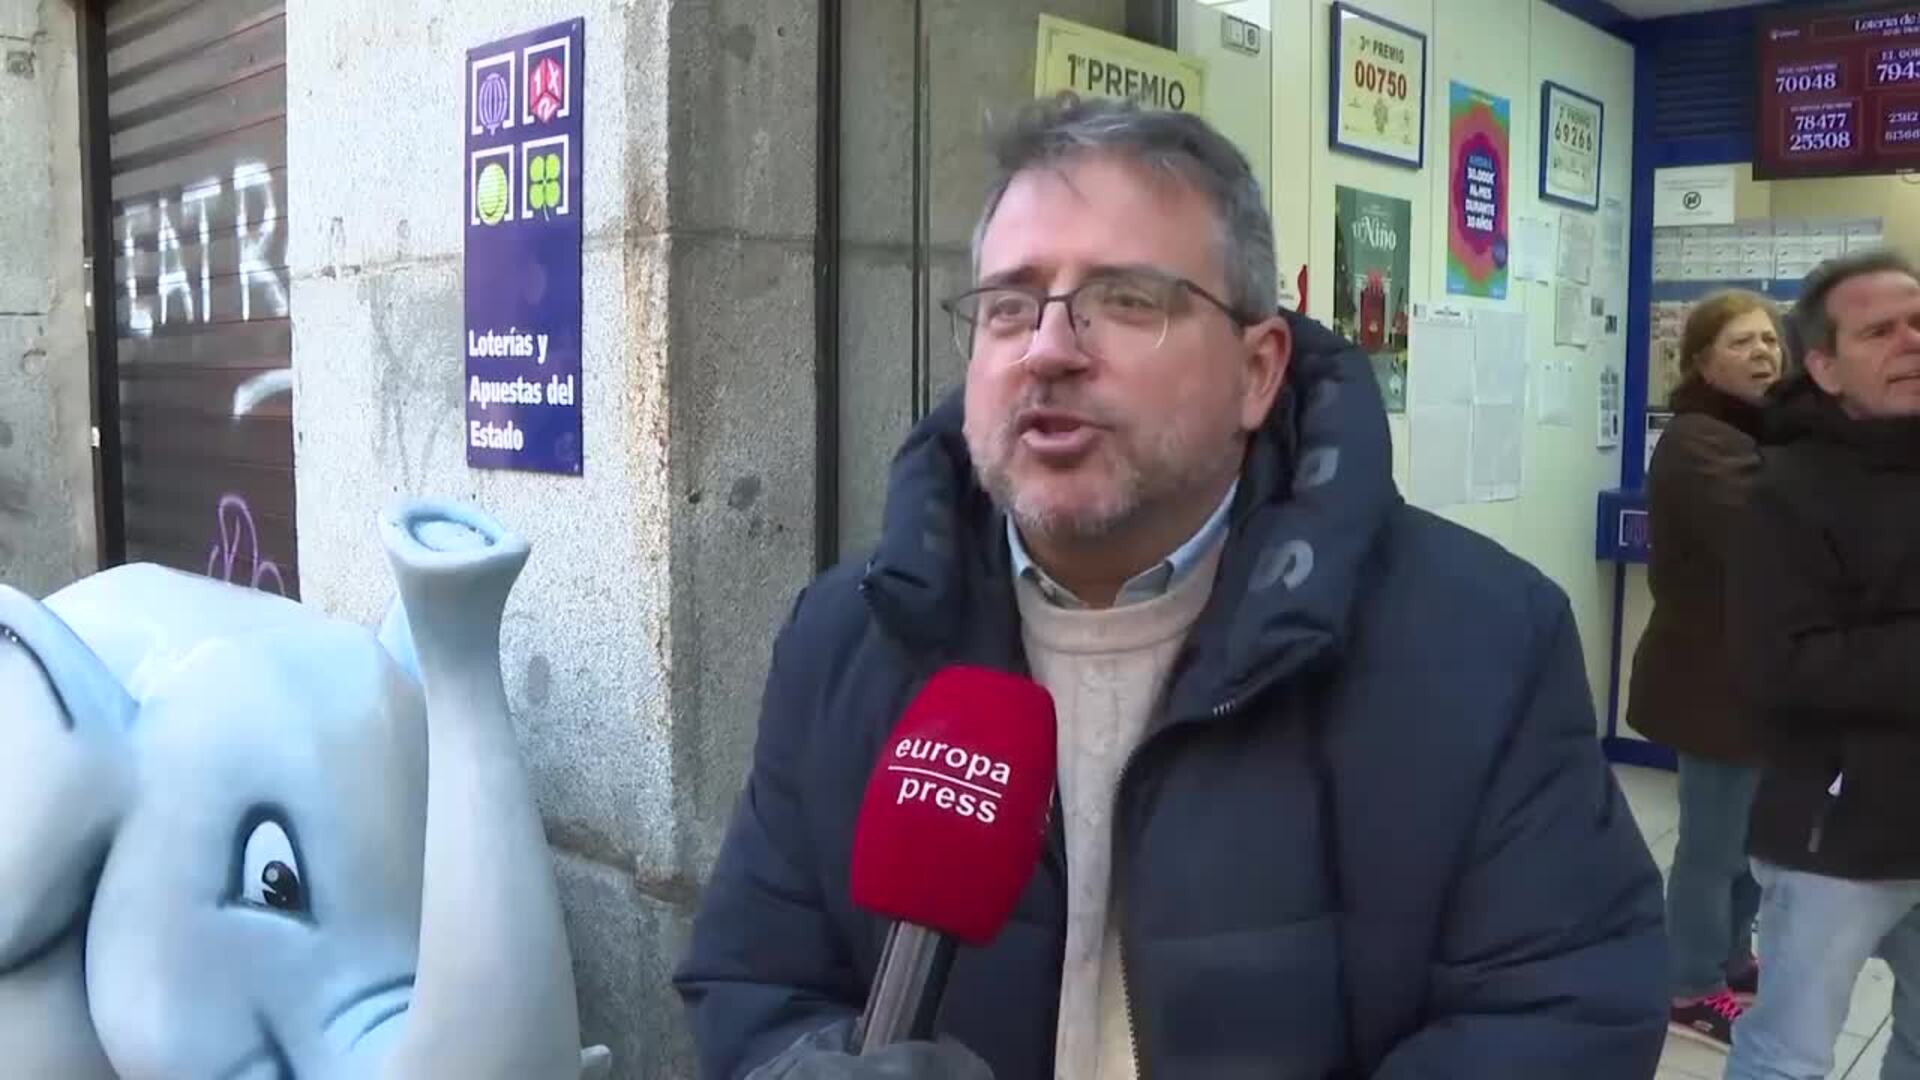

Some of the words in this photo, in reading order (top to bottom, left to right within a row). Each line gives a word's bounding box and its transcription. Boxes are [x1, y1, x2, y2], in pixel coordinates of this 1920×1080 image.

[1373, 39, 1405, 65] PREMIO
[1087, 58, 1186, 111] PREMIO
[1354, 59, 1408, 101] 00750
[1775, 72, 1837, 93] 70048
[1554, 120, 1592, 153] 69266
[1795, 113, 1847, 130] 78477
[1790, 131, 1850, 151] 25508
[468, 327, 533, 357] Loterías
[537, 334, 548, 364] y
[469, 375, 542, 410] Apuestas
[547, 374, 574, 405] del
[470, 420, 524, 451] Estado
[895, 737, 1011, 785] europa
[896, 777, 998, 823] press
